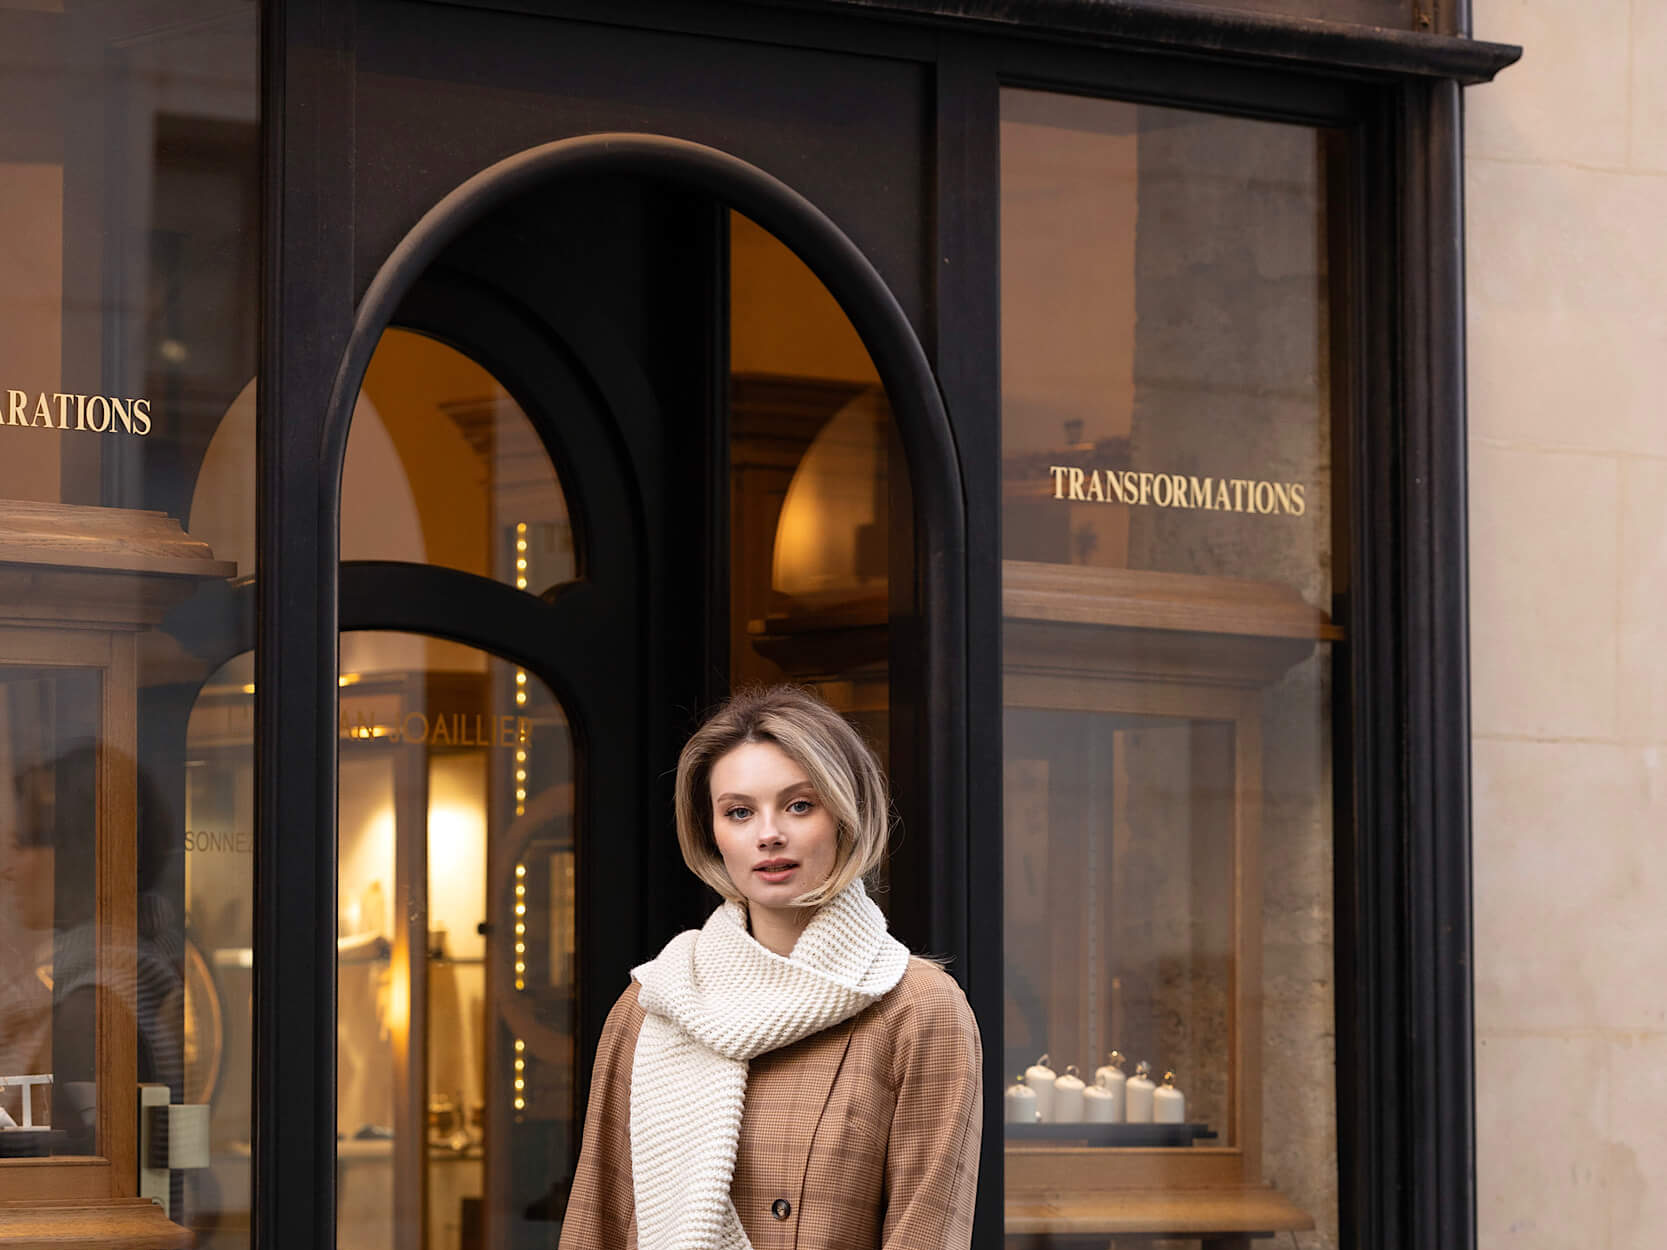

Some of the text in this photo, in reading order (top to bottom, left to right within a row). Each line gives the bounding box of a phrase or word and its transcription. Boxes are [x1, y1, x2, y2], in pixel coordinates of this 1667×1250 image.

[0, 389, 151, 435] RATIONS
[1050, 465, 1305, 516] TRANSFORMATIONS
[388, 711, 534, 748] JOAILLIER
